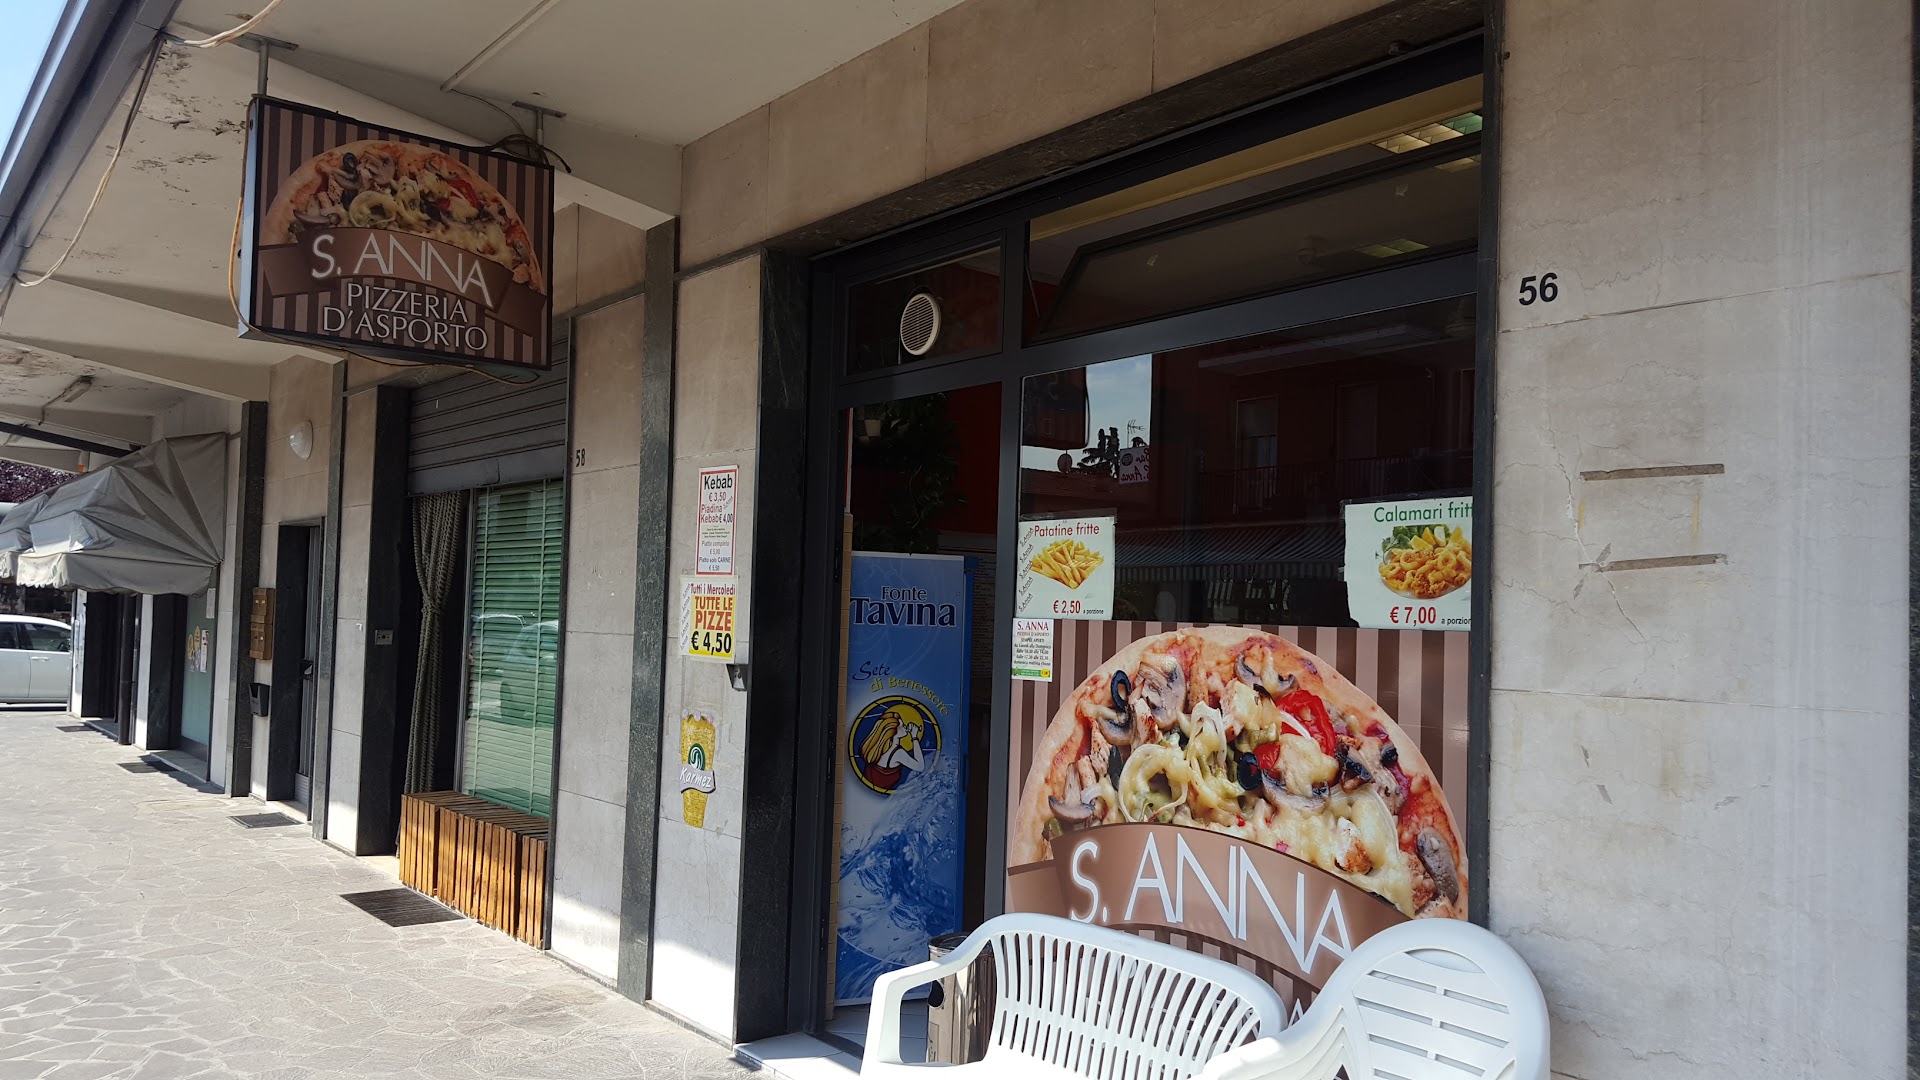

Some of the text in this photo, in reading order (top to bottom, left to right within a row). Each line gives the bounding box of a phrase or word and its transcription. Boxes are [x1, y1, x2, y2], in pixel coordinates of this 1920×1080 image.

[311, 232, 494, 308] S. ANNA
[1519, 272, 1558, 305] 56
[347, 282, 468, 323] PIZZERIA
[323, 306, 488, 350] D'ASPORTO
[575, 448, 585, 468] 58
[704, 473, 733, 490] Kebab
[709, 491, 727, 503] € 3,50
[700, 514, 719, 523] Kebab
[701, 504, 723, 514] Piadina
[1374, 503, 1442, 522] Calamari
[1034, 522, 1100, 537] Patatine fritte
[691, 583, 702, 594] Tutti
[881, 586, 927, 601] Fonte
[695, 596, 733, 611] TUTTE LE
[850, 597, 957, 628] Tavina
[1053, 600, 1059, 613] €
[1061, 600, 1081, 616] 2,50
[695, 610, 732, 631] PIZZE
[1017, 620, 1049, 631] S. ANNA
[1389, 606, 1399, 623] €
[1404, 606, 1437, 627] 7,00
[691, 630, 732, 655] € 4,50
[852, 660, 891, 681] Sete
[869, 676, 949, 716] di Benessere
[1071, 830, 1353, 975] S. ANNA
